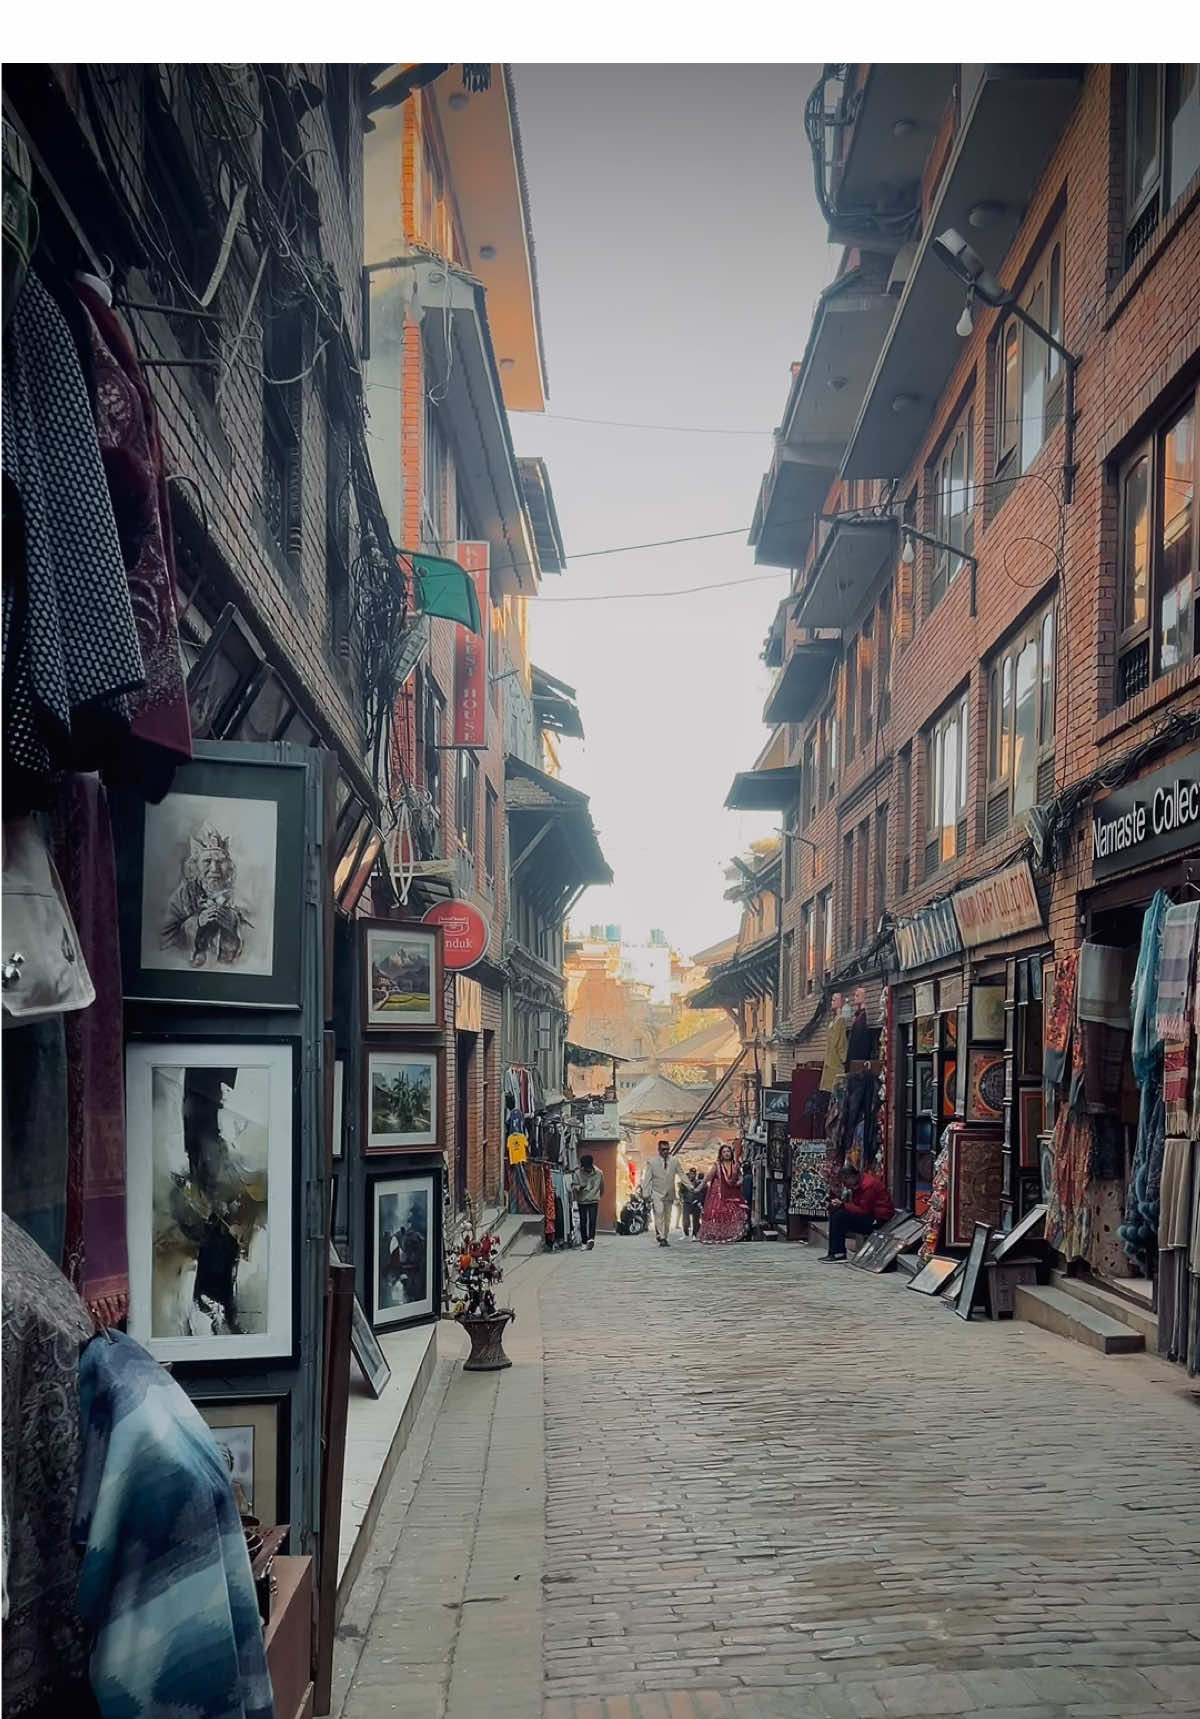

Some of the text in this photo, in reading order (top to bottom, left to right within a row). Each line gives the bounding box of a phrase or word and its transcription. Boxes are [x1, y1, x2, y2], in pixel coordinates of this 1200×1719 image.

[463, 626, 478, 742] UEST HOUSE
[1092, 779, 1200, 861] Namaste Collec
[445, 938, 473, 949] nduk
